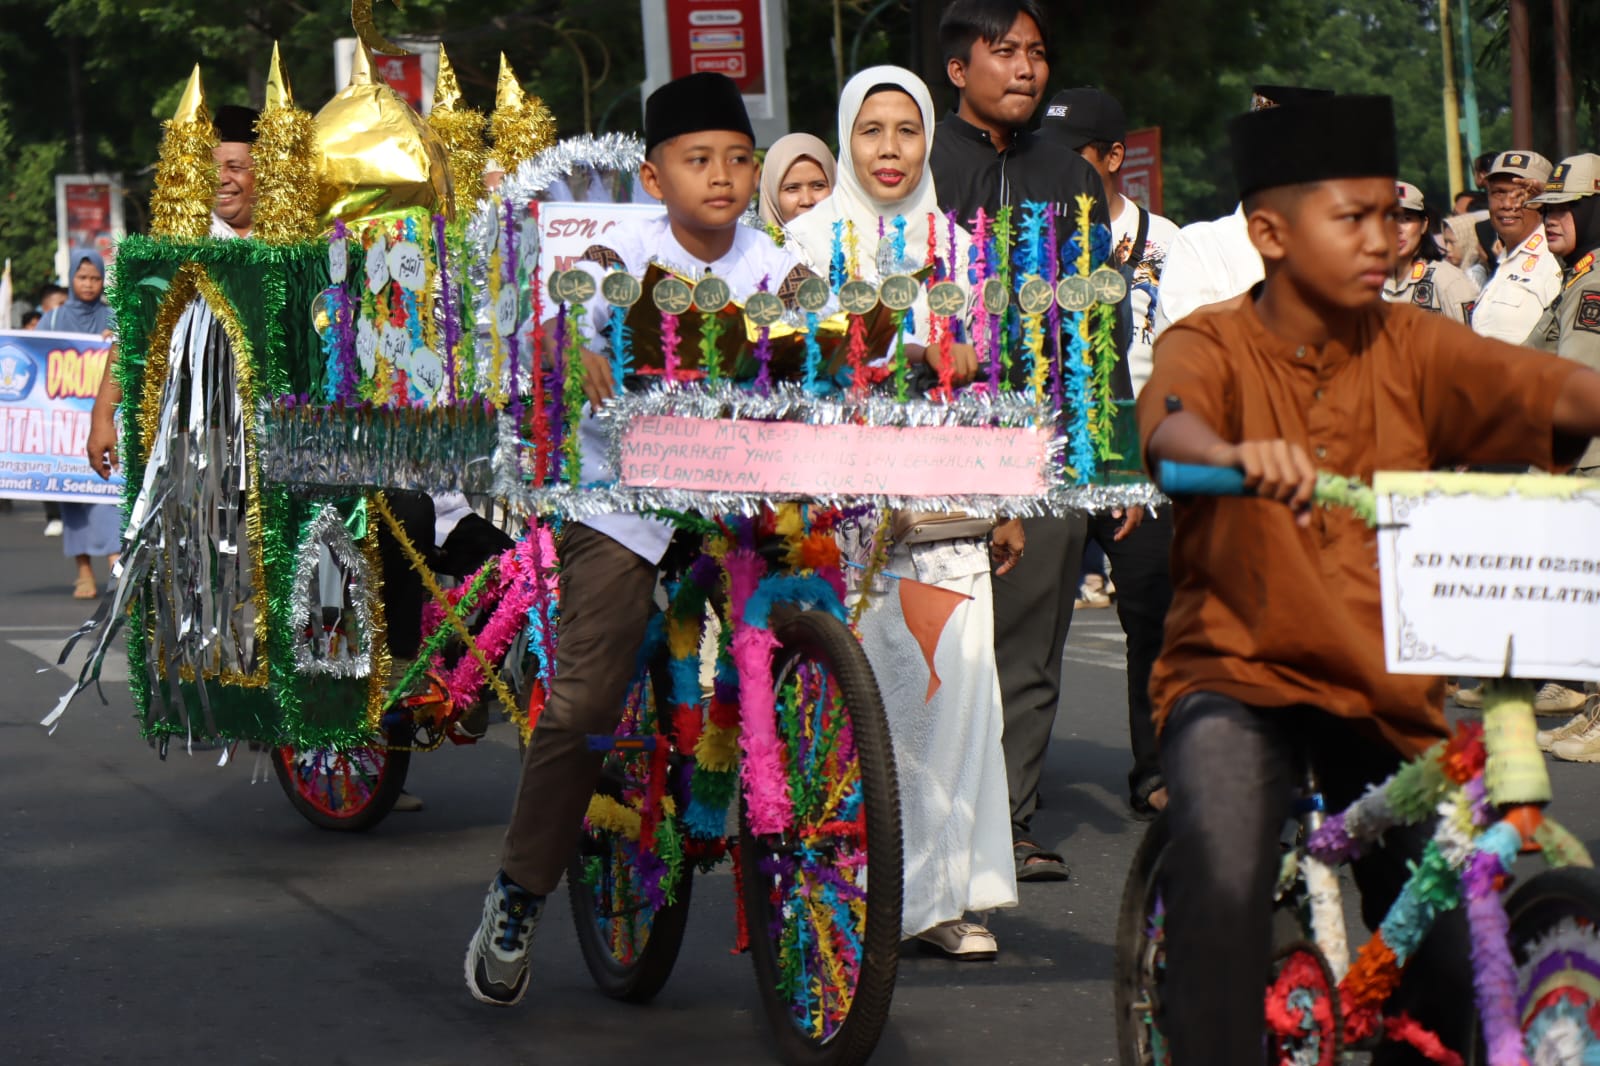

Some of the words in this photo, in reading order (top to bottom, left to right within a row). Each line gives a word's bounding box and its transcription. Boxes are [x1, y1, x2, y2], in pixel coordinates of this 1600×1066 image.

[546, 218, 598, 238] SDN
[715, 424, 751, 445] MTQ
[744, 448, 784, 465] YANG
[1412, 553, 1442, 569] SD
[1449, 554, 1533, 571] NEGERI
[1432, 582, 1506, 599] BINJAI
